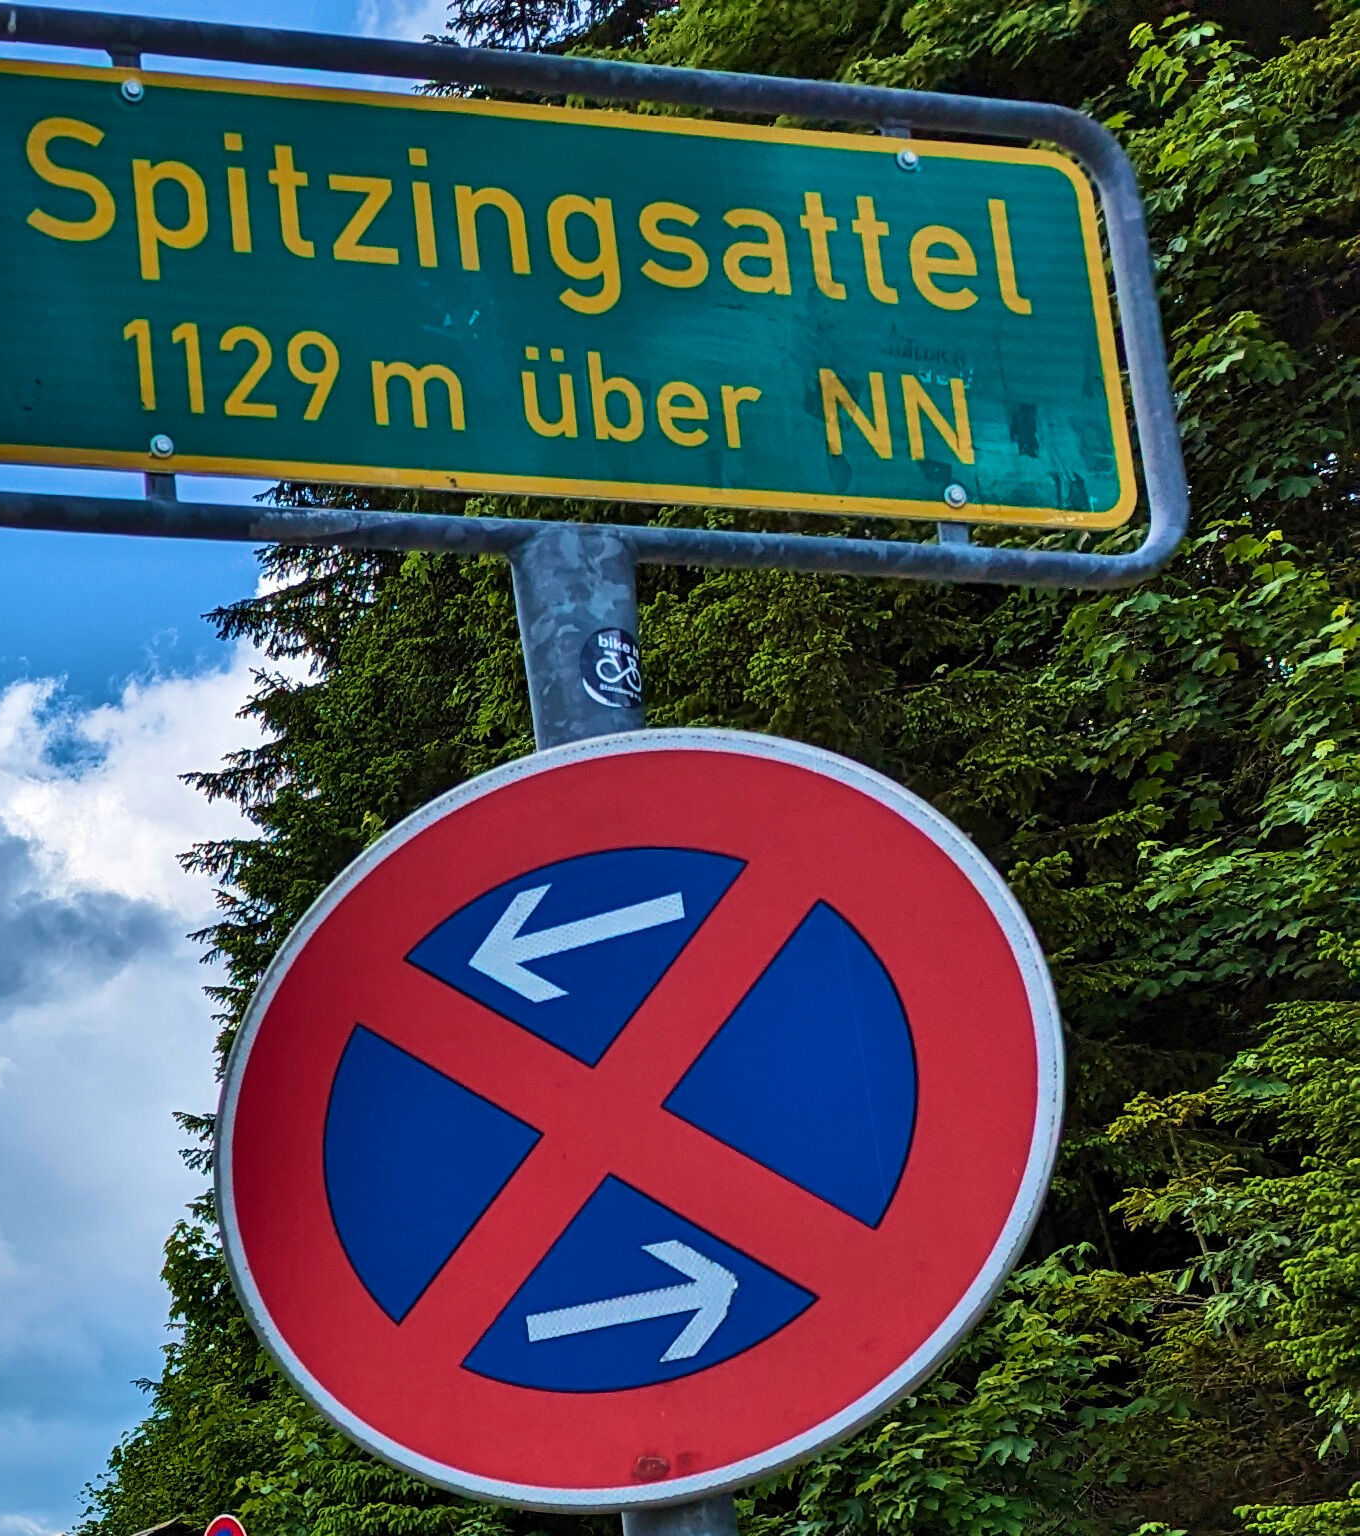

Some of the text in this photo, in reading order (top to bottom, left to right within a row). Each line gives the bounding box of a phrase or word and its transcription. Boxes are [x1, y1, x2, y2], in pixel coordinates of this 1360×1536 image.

[27, 117, 1031, 314] Spitzingsattel
[125, 319, 975, 464] 1129 m über NN
[598, 634, 630, 653] bike
